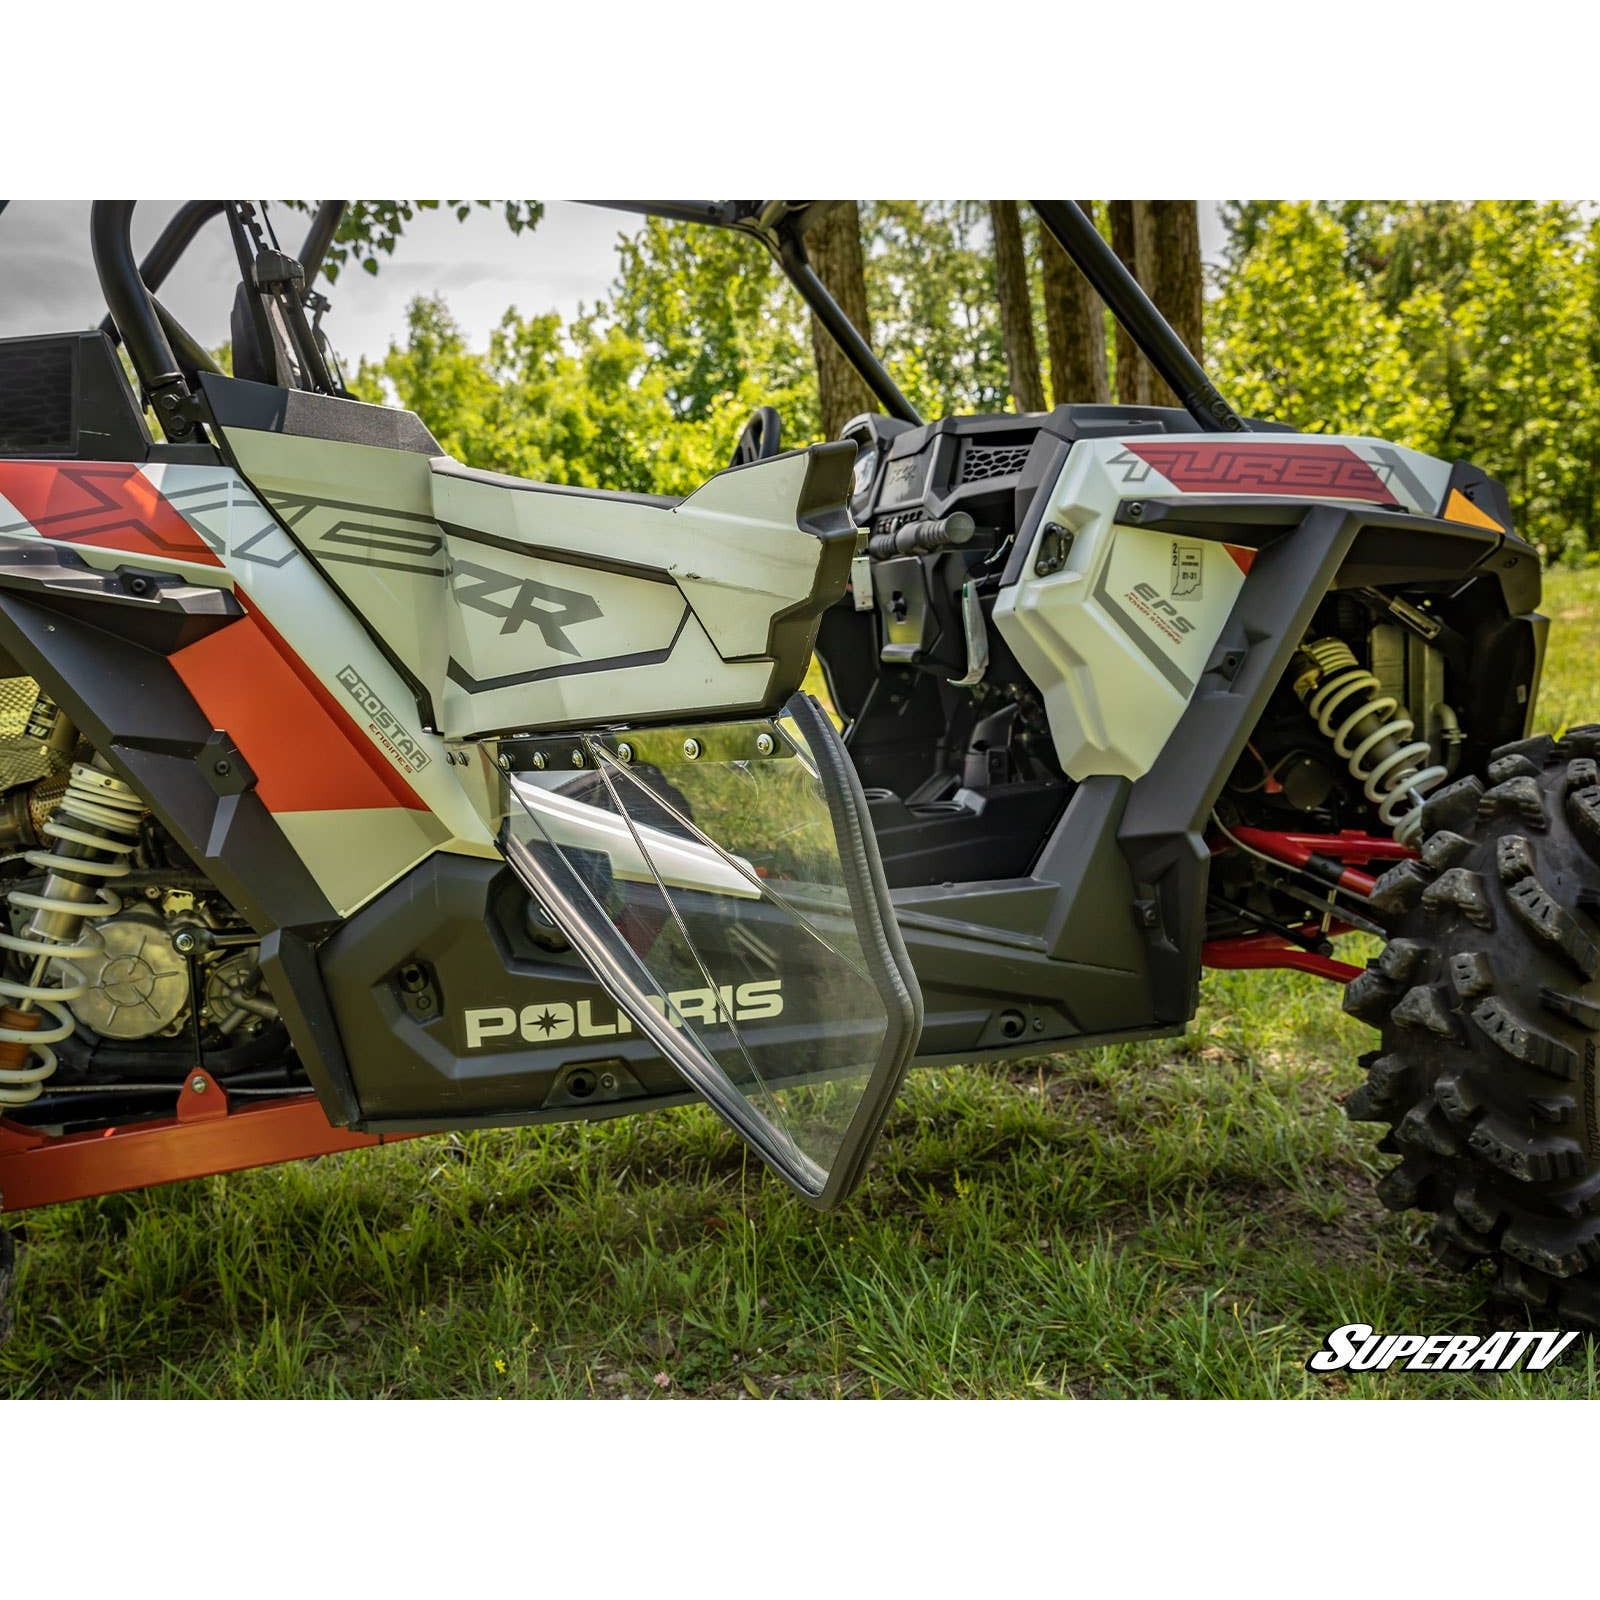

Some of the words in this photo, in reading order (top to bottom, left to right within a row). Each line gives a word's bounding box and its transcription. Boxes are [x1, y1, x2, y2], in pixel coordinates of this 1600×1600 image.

[1106, 450, 1394, 493] TURBO
[1133, 582, 1196, 634] EPS
[338, 667, 428, 769] PROSTAR
